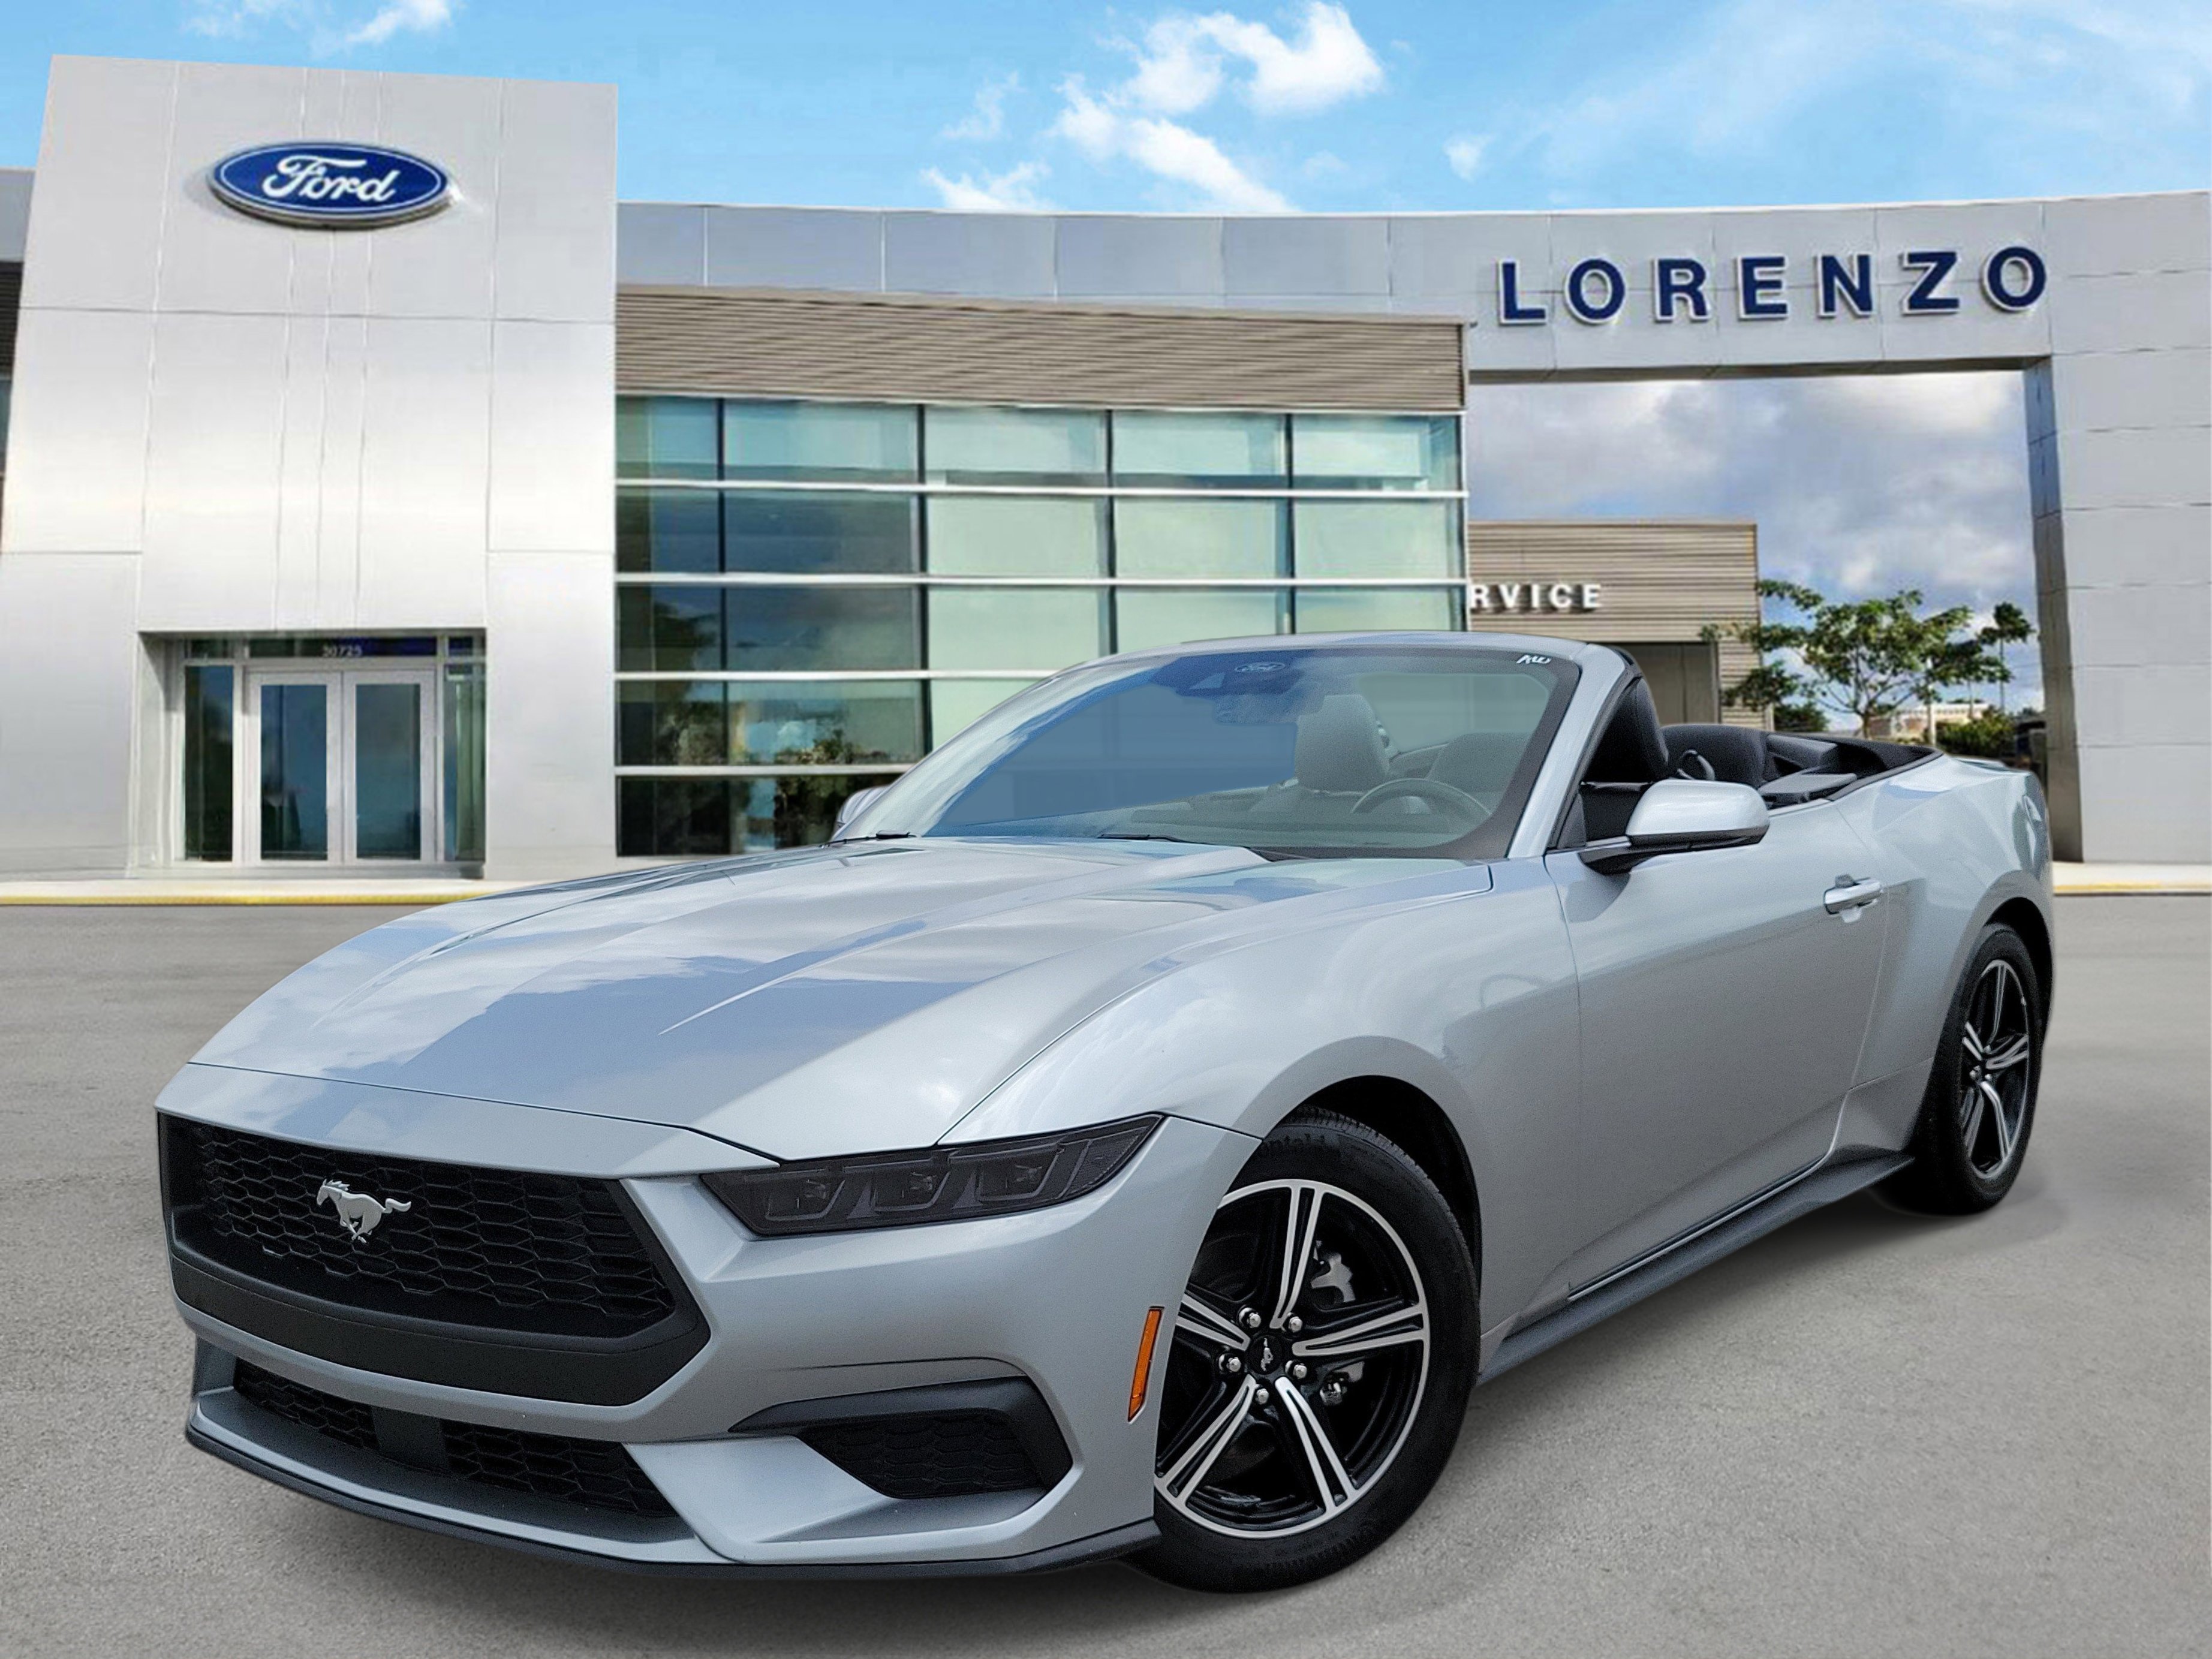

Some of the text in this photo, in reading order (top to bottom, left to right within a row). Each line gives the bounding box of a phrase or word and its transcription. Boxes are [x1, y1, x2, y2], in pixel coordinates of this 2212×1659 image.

[262, 155, 401, 201] Ford
[1496, 246, 2048, 326] LORENZO
[1470, 583, 1602, 609] RVICE
